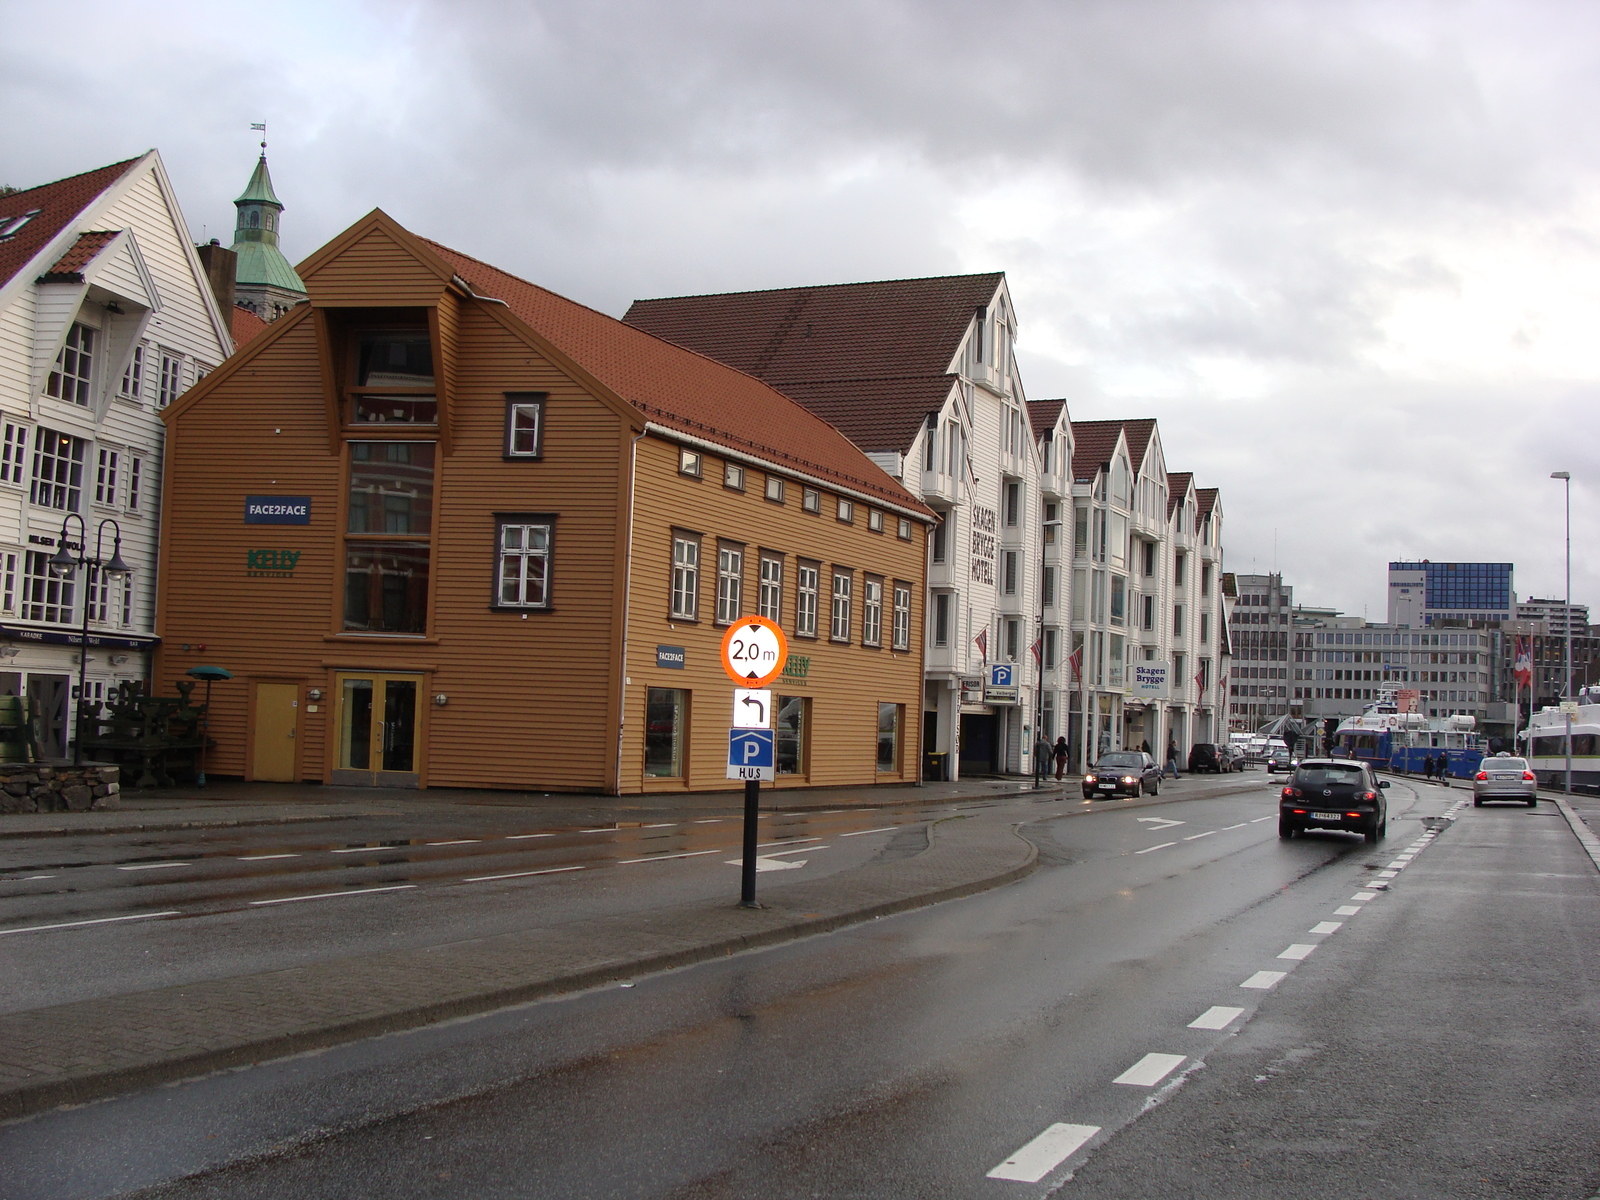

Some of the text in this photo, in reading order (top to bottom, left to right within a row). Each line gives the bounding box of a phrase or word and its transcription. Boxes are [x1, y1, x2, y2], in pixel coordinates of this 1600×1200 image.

[249, 504, 306, 515] FACE2FACE
[972, 504, 995, 534] SKAGEN
[29, 535, 54, 547] NILSEN
[972, 531, 994, 559] BRYGGE
[247, 549, 301, 570] KELLY
[971, 557, 994, 585] HOTELL
[20, 632, 43, 640] KARAOKE
[659, 652, 684, 662] FACE2FACE
[732, 639, 775, 662] 2,0 m
[997, 671, 1007, 684] P
[1136, 666, 1166, 676] Skagen
[1136, 675, 1165, 685] Brygge
[744, 741, 760, 764] P
